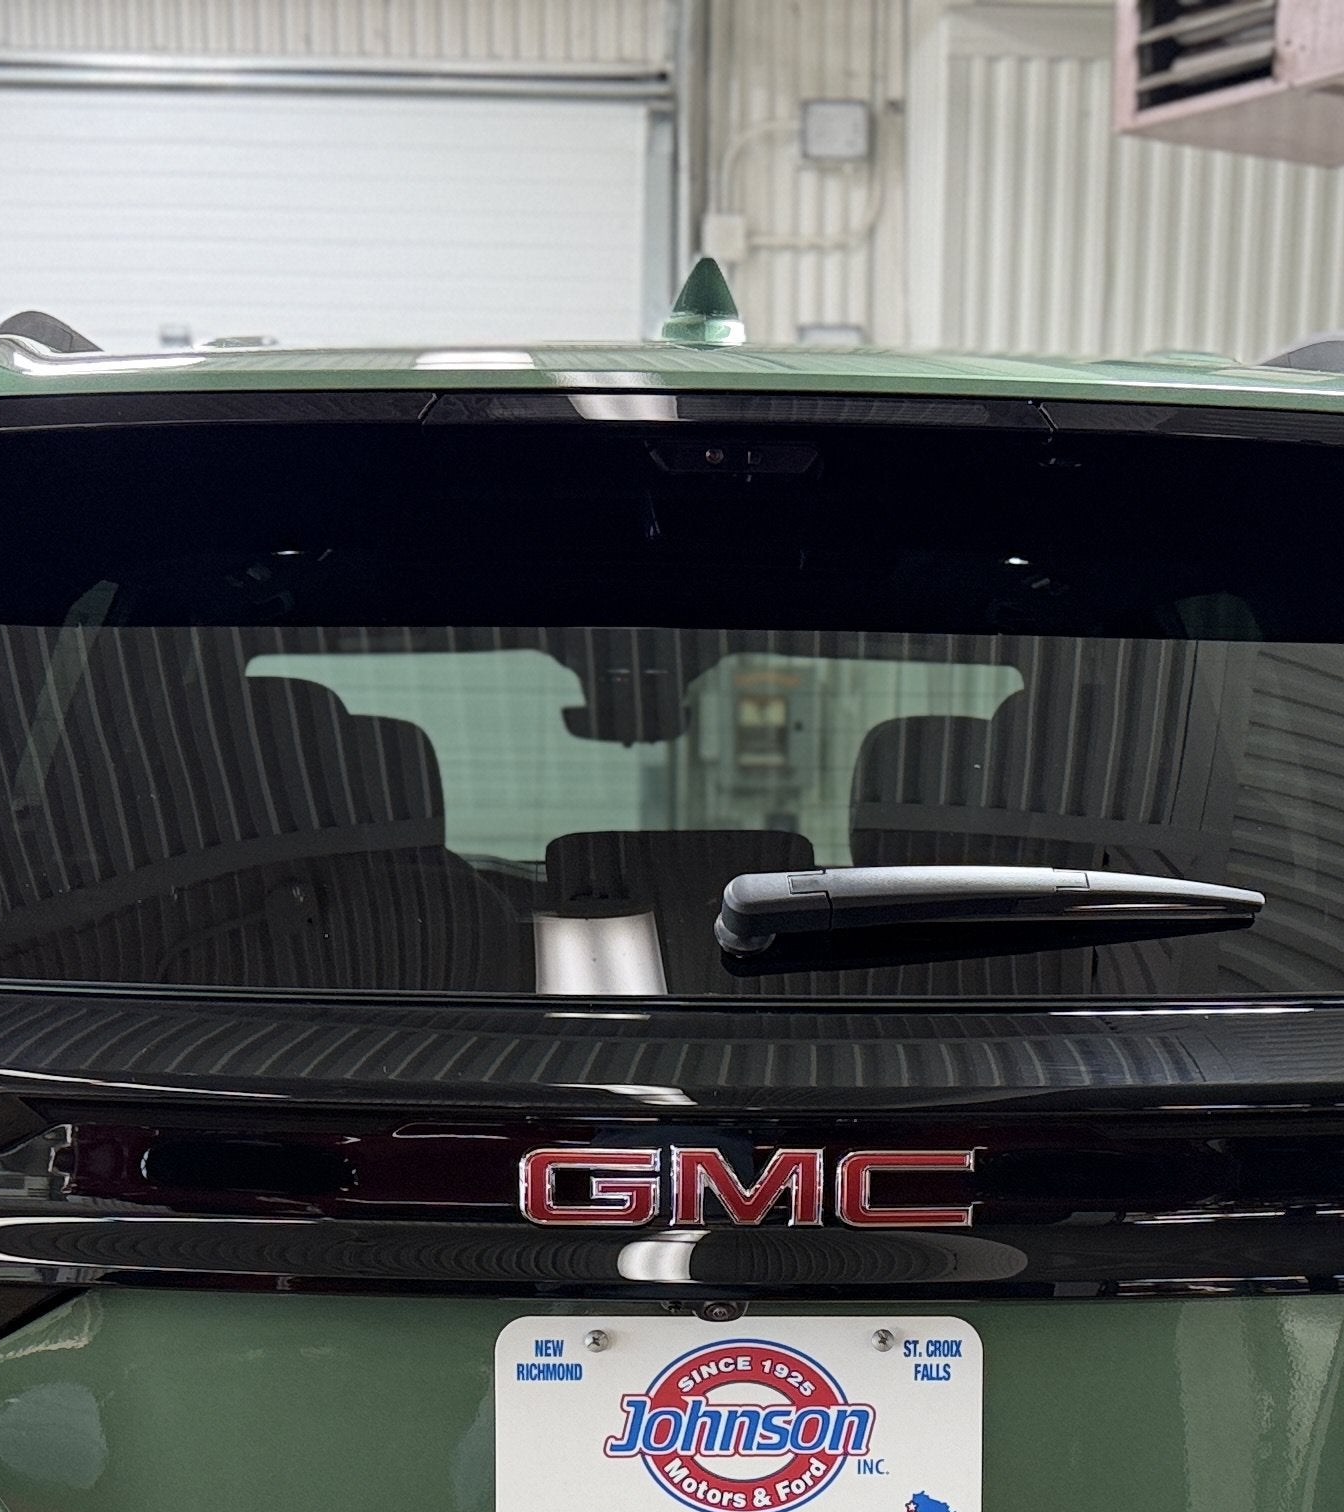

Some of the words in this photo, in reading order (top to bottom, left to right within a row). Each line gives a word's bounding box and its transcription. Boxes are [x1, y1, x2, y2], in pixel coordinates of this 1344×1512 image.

[519, 1145, 975, 1228] GMC
[534, 1339, 564, 1358] NEW
[903, 1339, 923, 1358] ST.
[925, 1339, 963, 1358] CROIX
[516, 1363, 583, 1382] RICHMOND
[677, 1357, 752, 1394] SINCE
[762, 1359, 816, 1397] 1925
[914, 1363, 951, 1382] FALLS
[606, 1396, 874, 1455] Johnson
[856, 1459, 890, 1476] INC.
[664, 1457, 747, 1508] Motors
[752, 1489, 772, 1508] &
[777, 1459, 828, 1500] Ford
